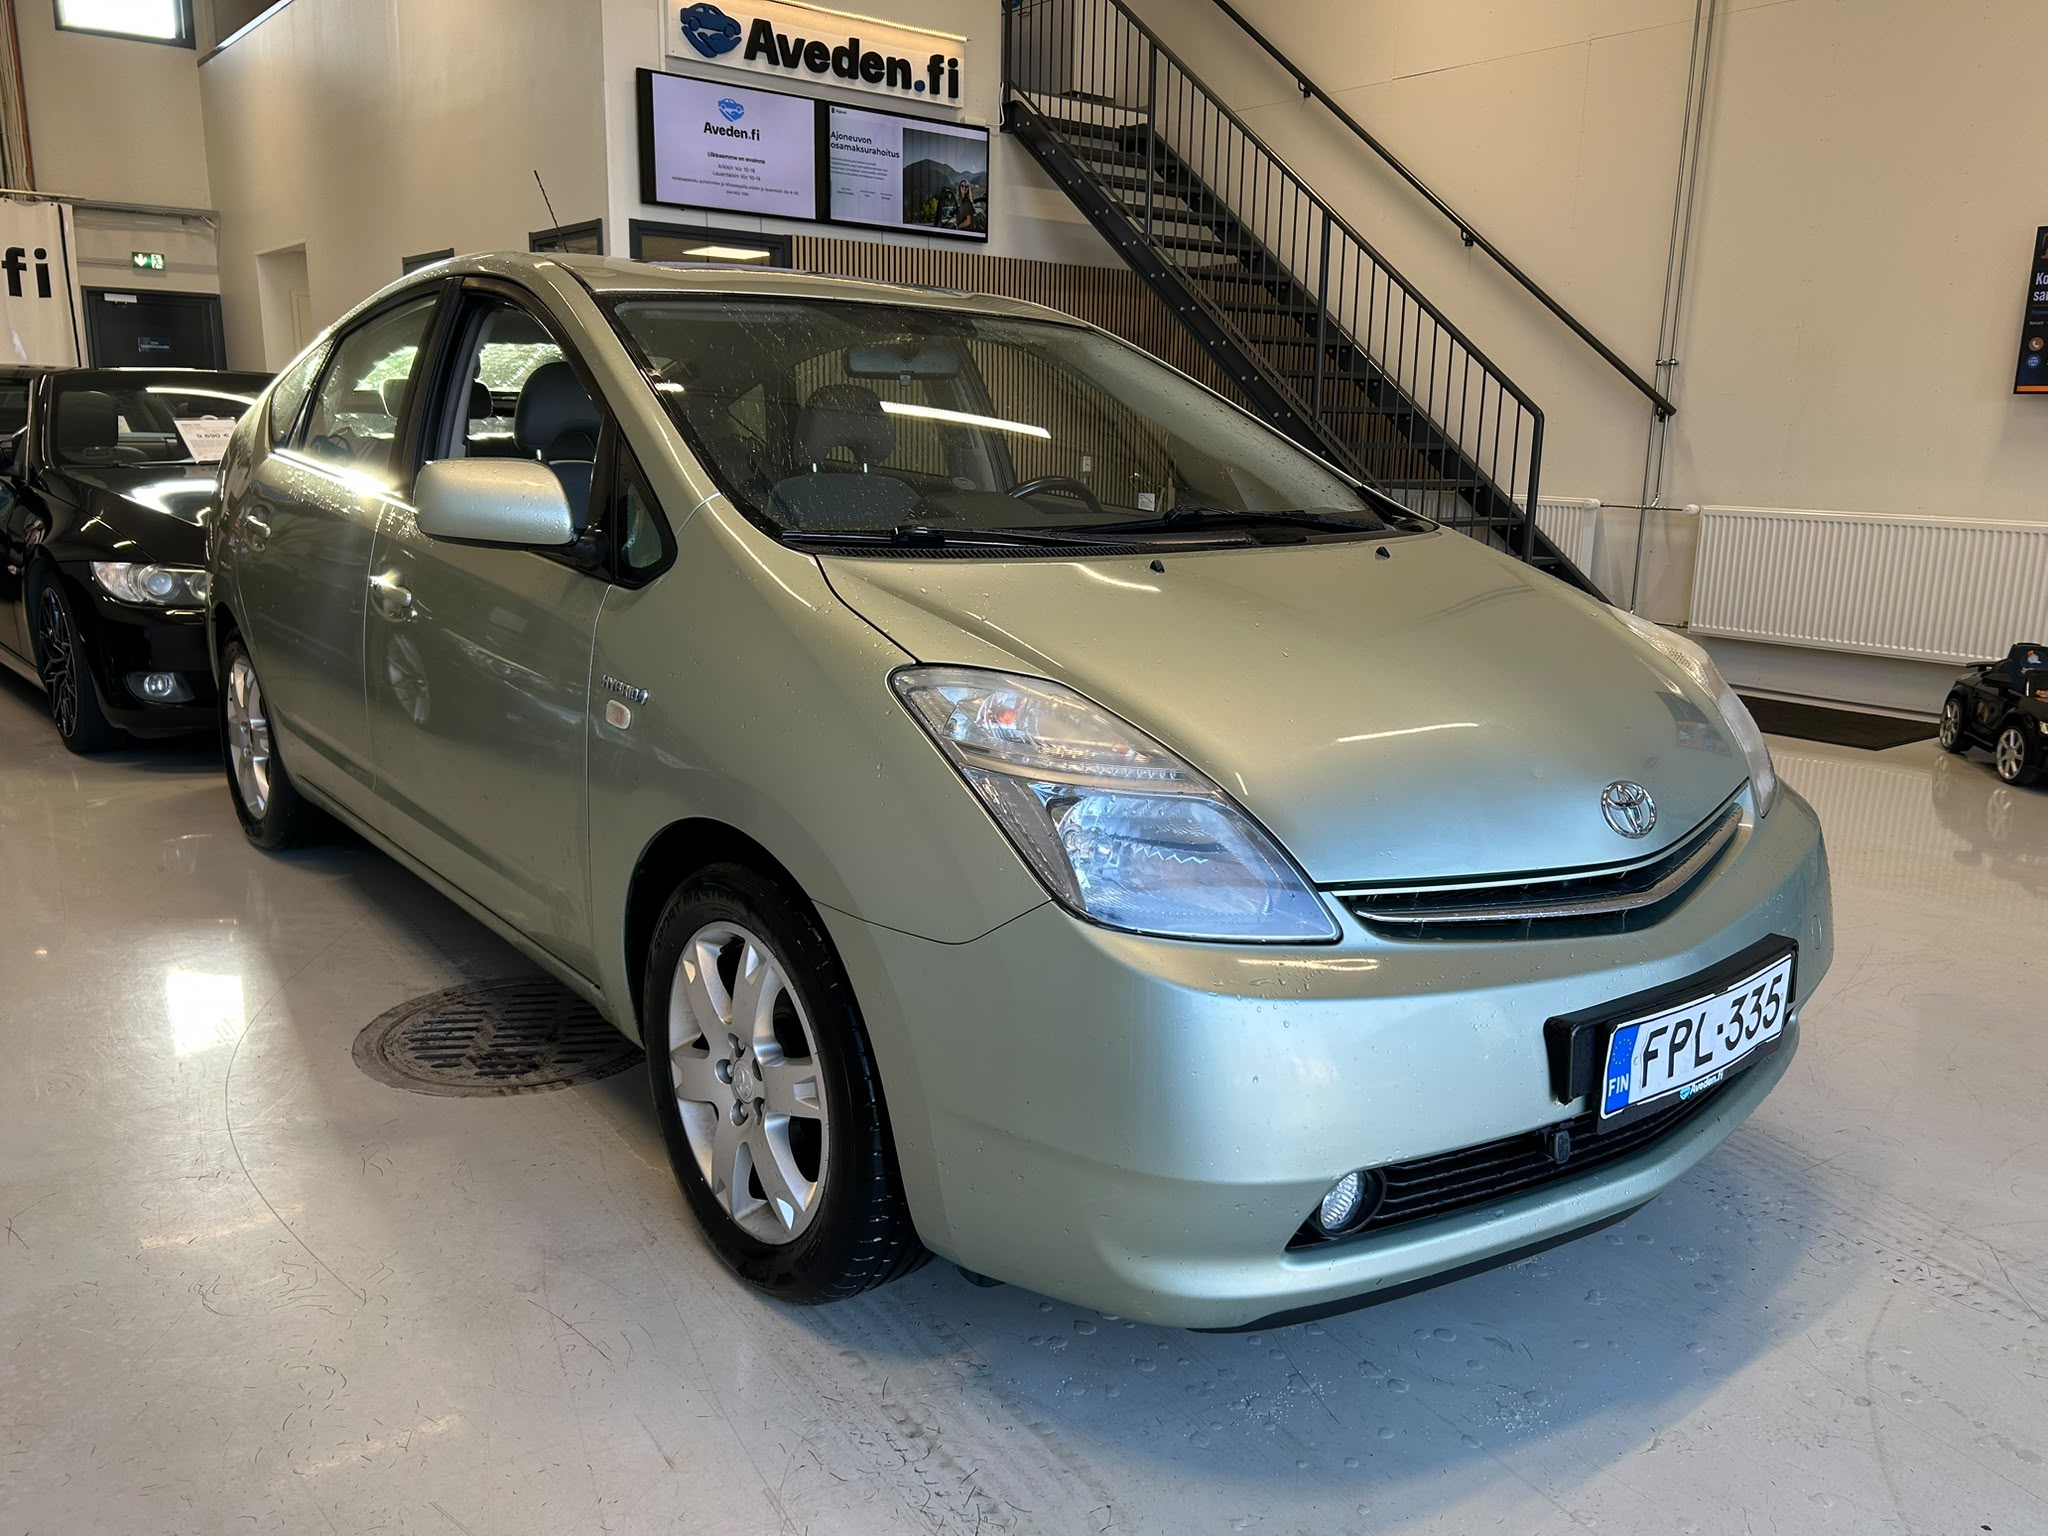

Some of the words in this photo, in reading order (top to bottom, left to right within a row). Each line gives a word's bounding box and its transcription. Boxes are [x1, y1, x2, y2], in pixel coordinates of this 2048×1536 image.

[743, 18, 959, 98] Aveden.fi
[703, 121, 760, 141] Aveden.fi
[830, 131, 872, 145] Ajoneuvon
[830, 142, 900, 159] osamaksurahoitus
[1641, 973, 1783, 1089] FPL-335
[1608, 1072, 1630, 1097] FIN
